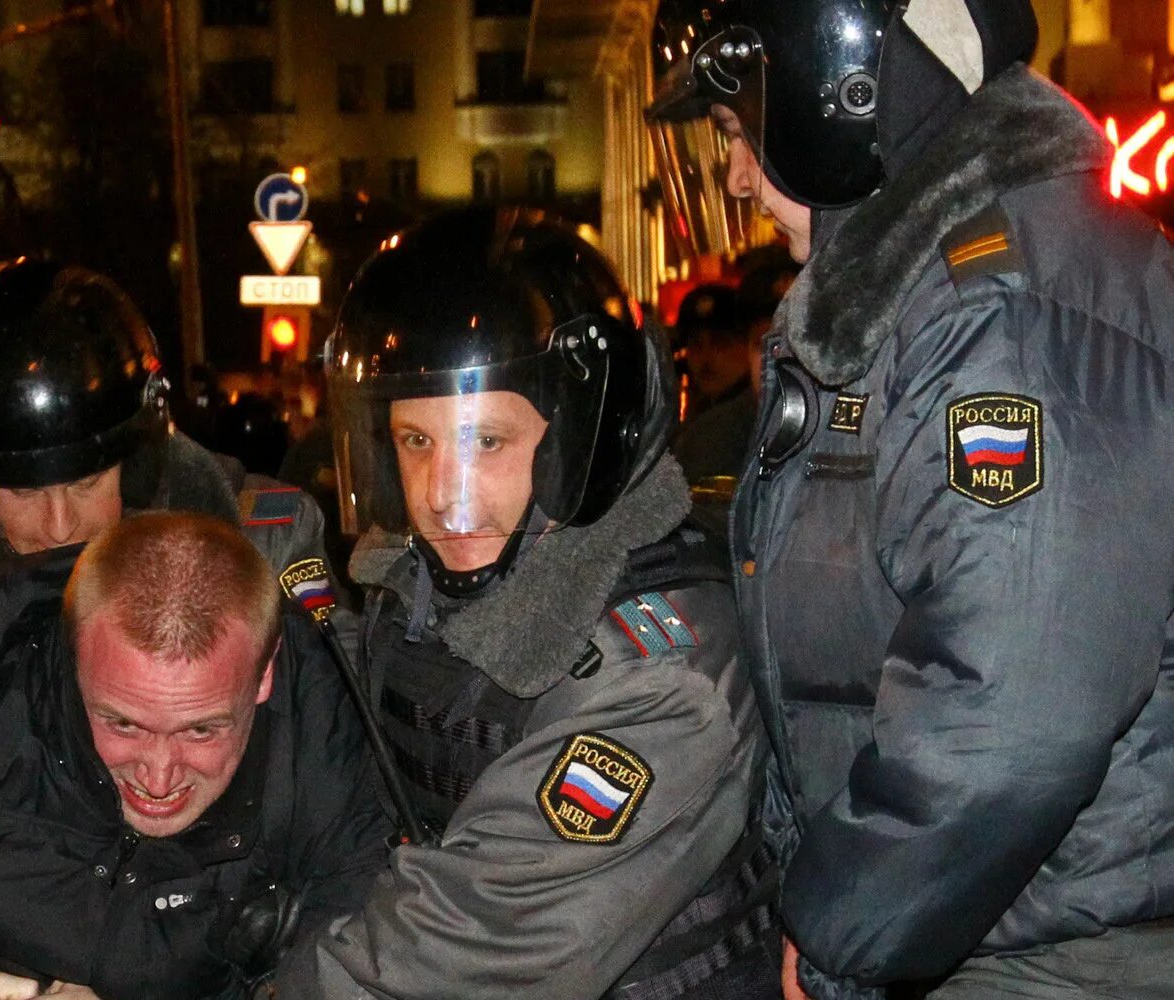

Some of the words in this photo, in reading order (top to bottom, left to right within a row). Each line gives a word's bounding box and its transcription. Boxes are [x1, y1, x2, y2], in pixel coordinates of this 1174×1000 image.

[252, 281, 309, 299] СТОП
[954, 406, 1032, 425] РОССИЯ
[971, 468, 1014, 491] МВД
[573, 743, 644, 789] РОССИЯ
[556, 800, 597, 835] МВД
